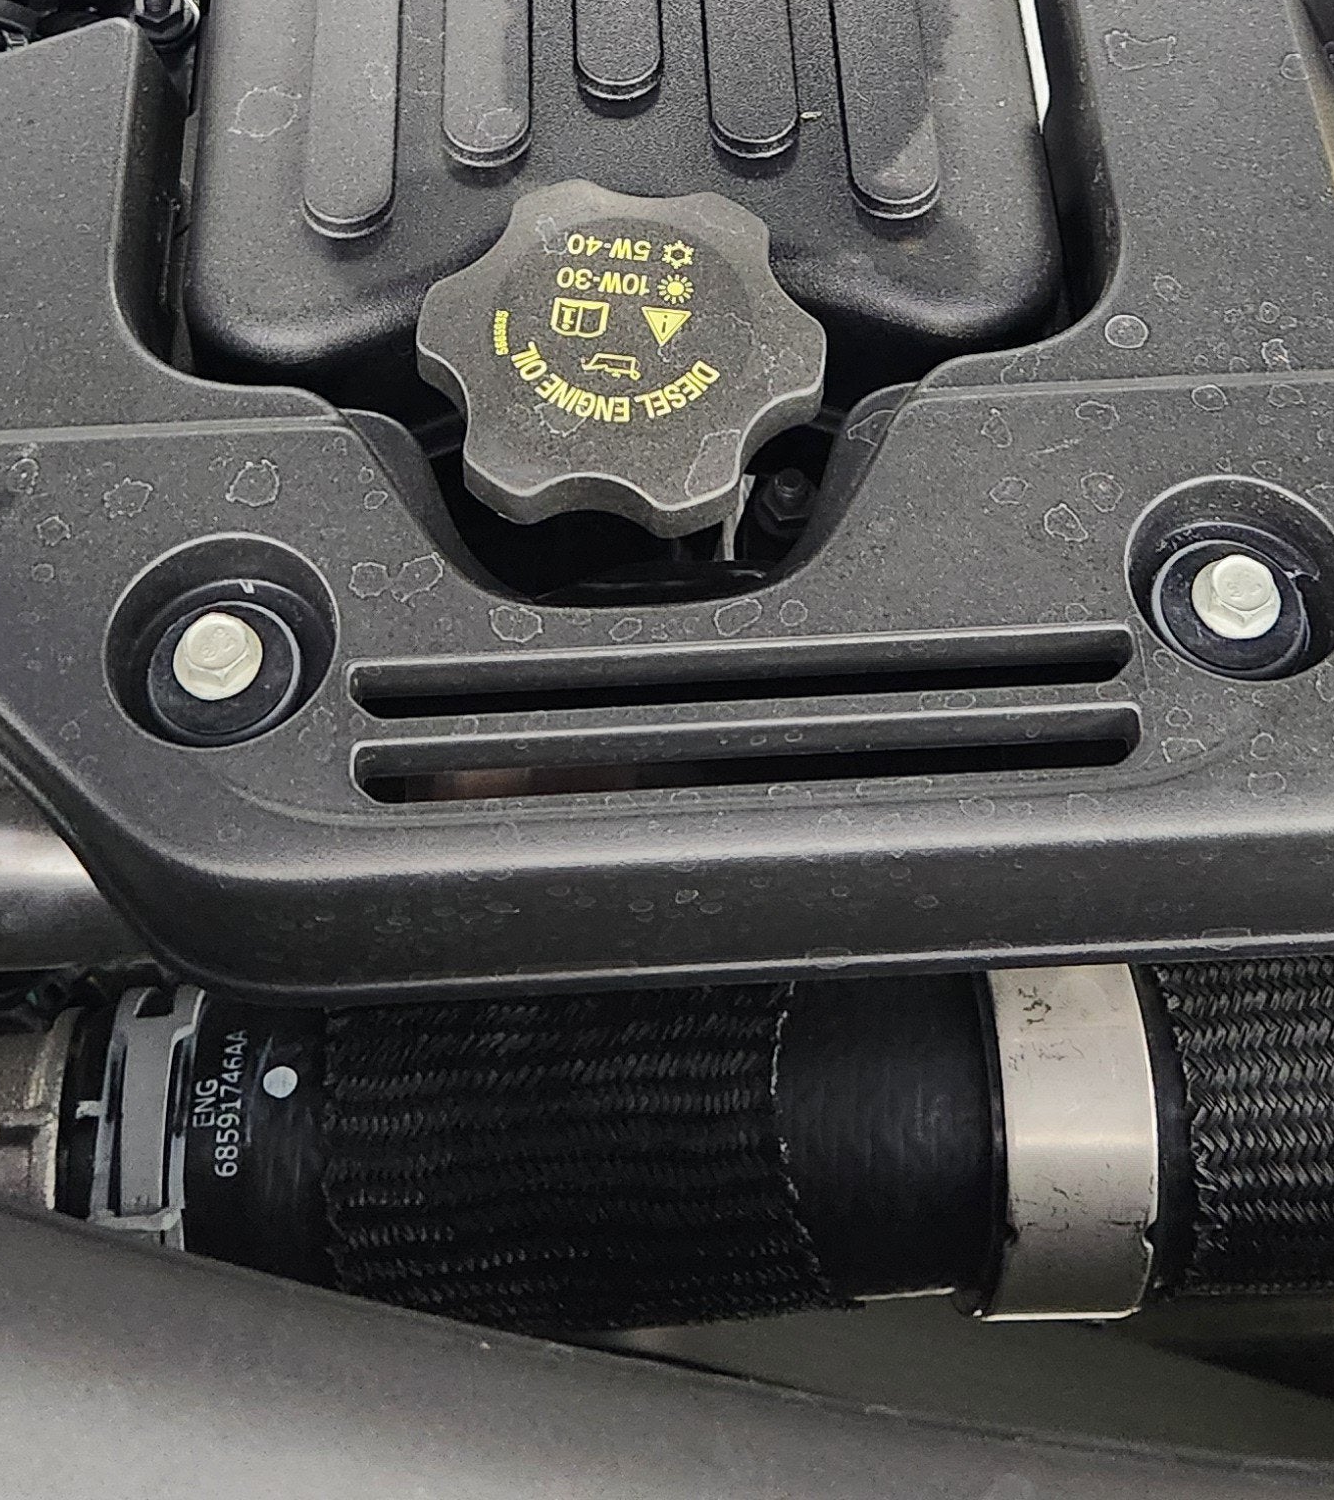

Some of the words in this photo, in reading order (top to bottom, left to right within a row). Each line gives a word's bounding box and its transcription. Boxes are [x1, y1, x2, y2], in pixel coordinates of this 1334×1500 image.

[567, 233, 652, 262] 5W-40
[556, 266, 651, 295] 10W-30
[511, 340, 548, 382] OIL
[534, 373, 631, 422] ENGINE
[634, 359, 722, 419] DIESEL
[192, 1077, 219, 1129] ENG
[214, 1030, 248, 1179] 68591746AA
